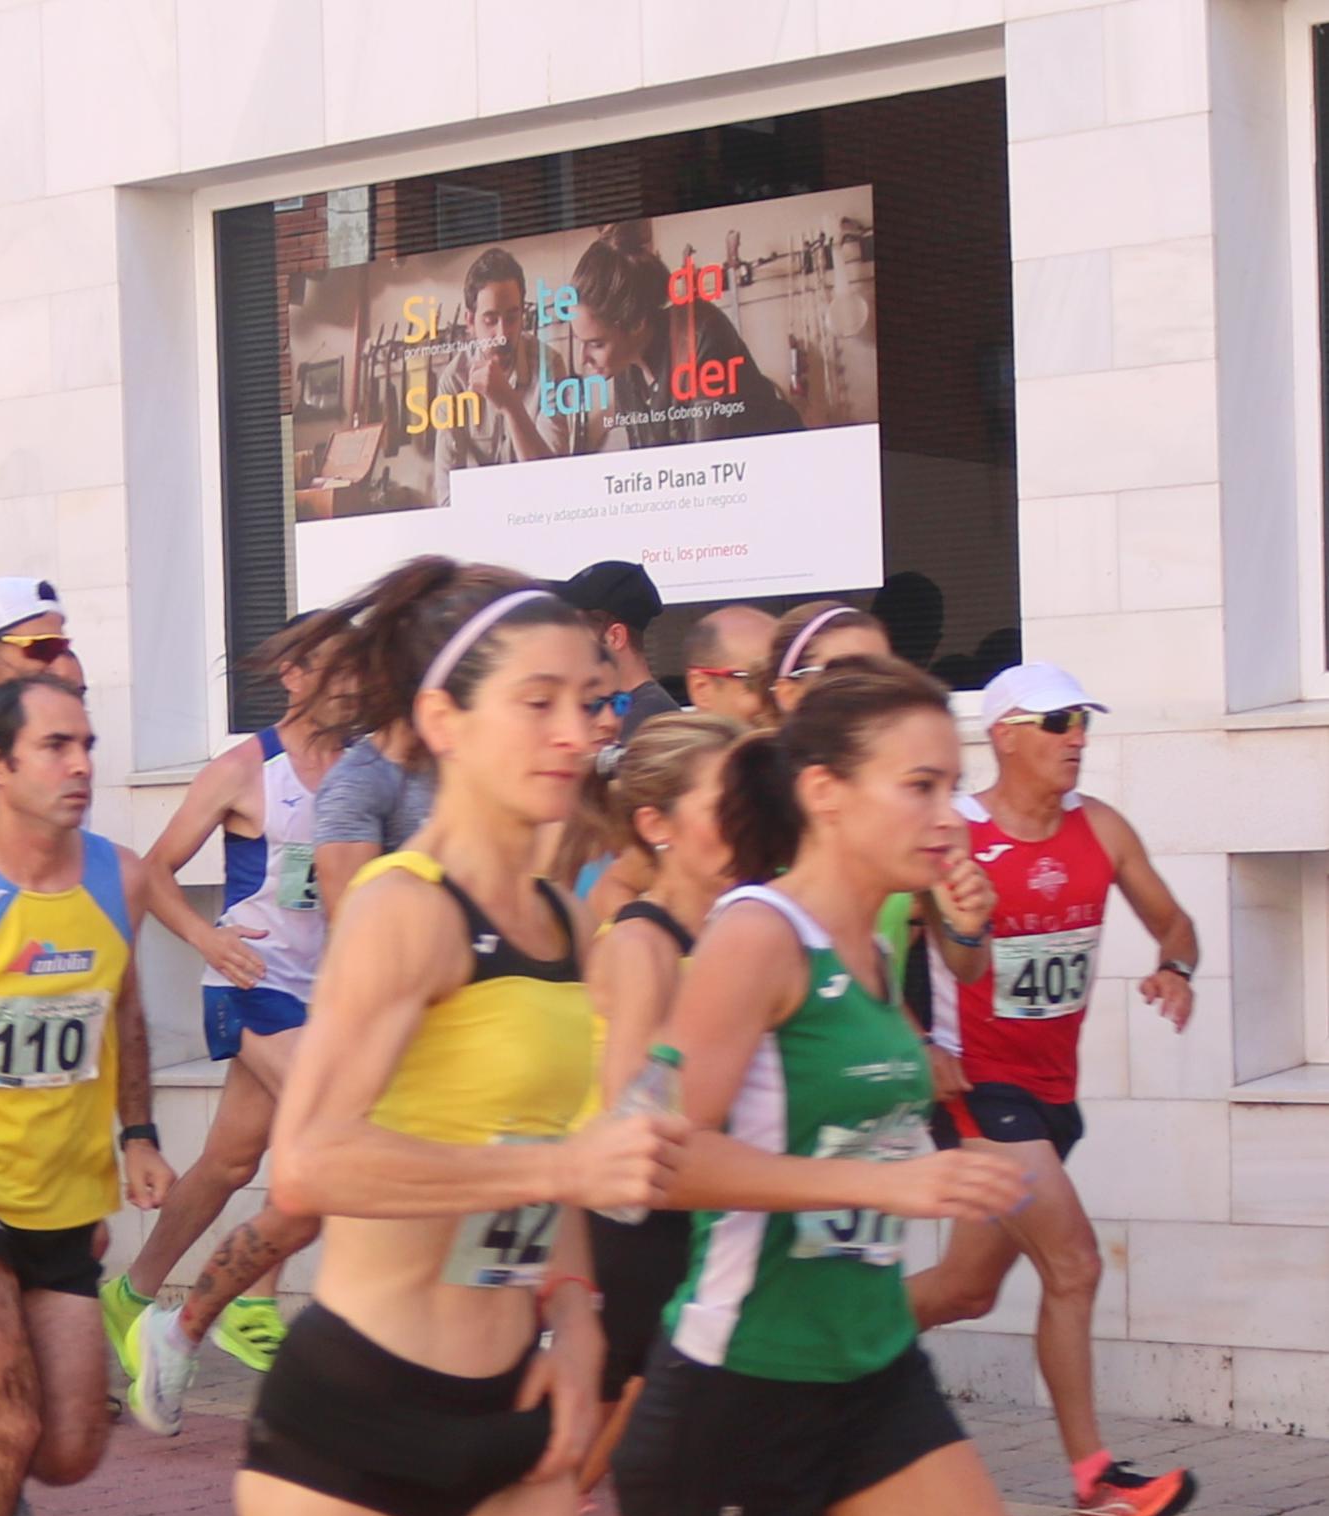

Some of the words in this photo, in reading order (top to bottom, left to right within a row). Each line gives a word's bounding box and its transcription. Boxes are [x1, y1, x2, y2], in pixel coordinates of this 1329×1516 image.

[403, 295, 438, 344] Si
[536, 279, 579, 325] te
[668, 256, 724, 305] da
[405, 386, 481, 434] San
[538, 373, 609, 418] tan
[671, 355, 745, 400] der
[603, 415, 614, 429] te
[615, 408, 649, 427] facilita
[650, 406, 666, 422] los
[667, 402, 703, 421] Cobros
[713, 400, 746, 419] Pagos
[604, 472, 653, 496] Tarifa
[658, 467, 707, 491] Plana
[710, 462, 747, 484] TPV
[507, 510, 544, 526] Flexible
[554, 504, 599, 523] adaptada
[678, 494, 692, 509] de
[693, 494, 705, 507] tu
[706, 490, 748, 509] negocio
[642, 547, 661, 564] Por
[676, 545, 694, 561] los
[695, 541, 748, 563] primeros
[1011, 952, 1089, 1006] 403
